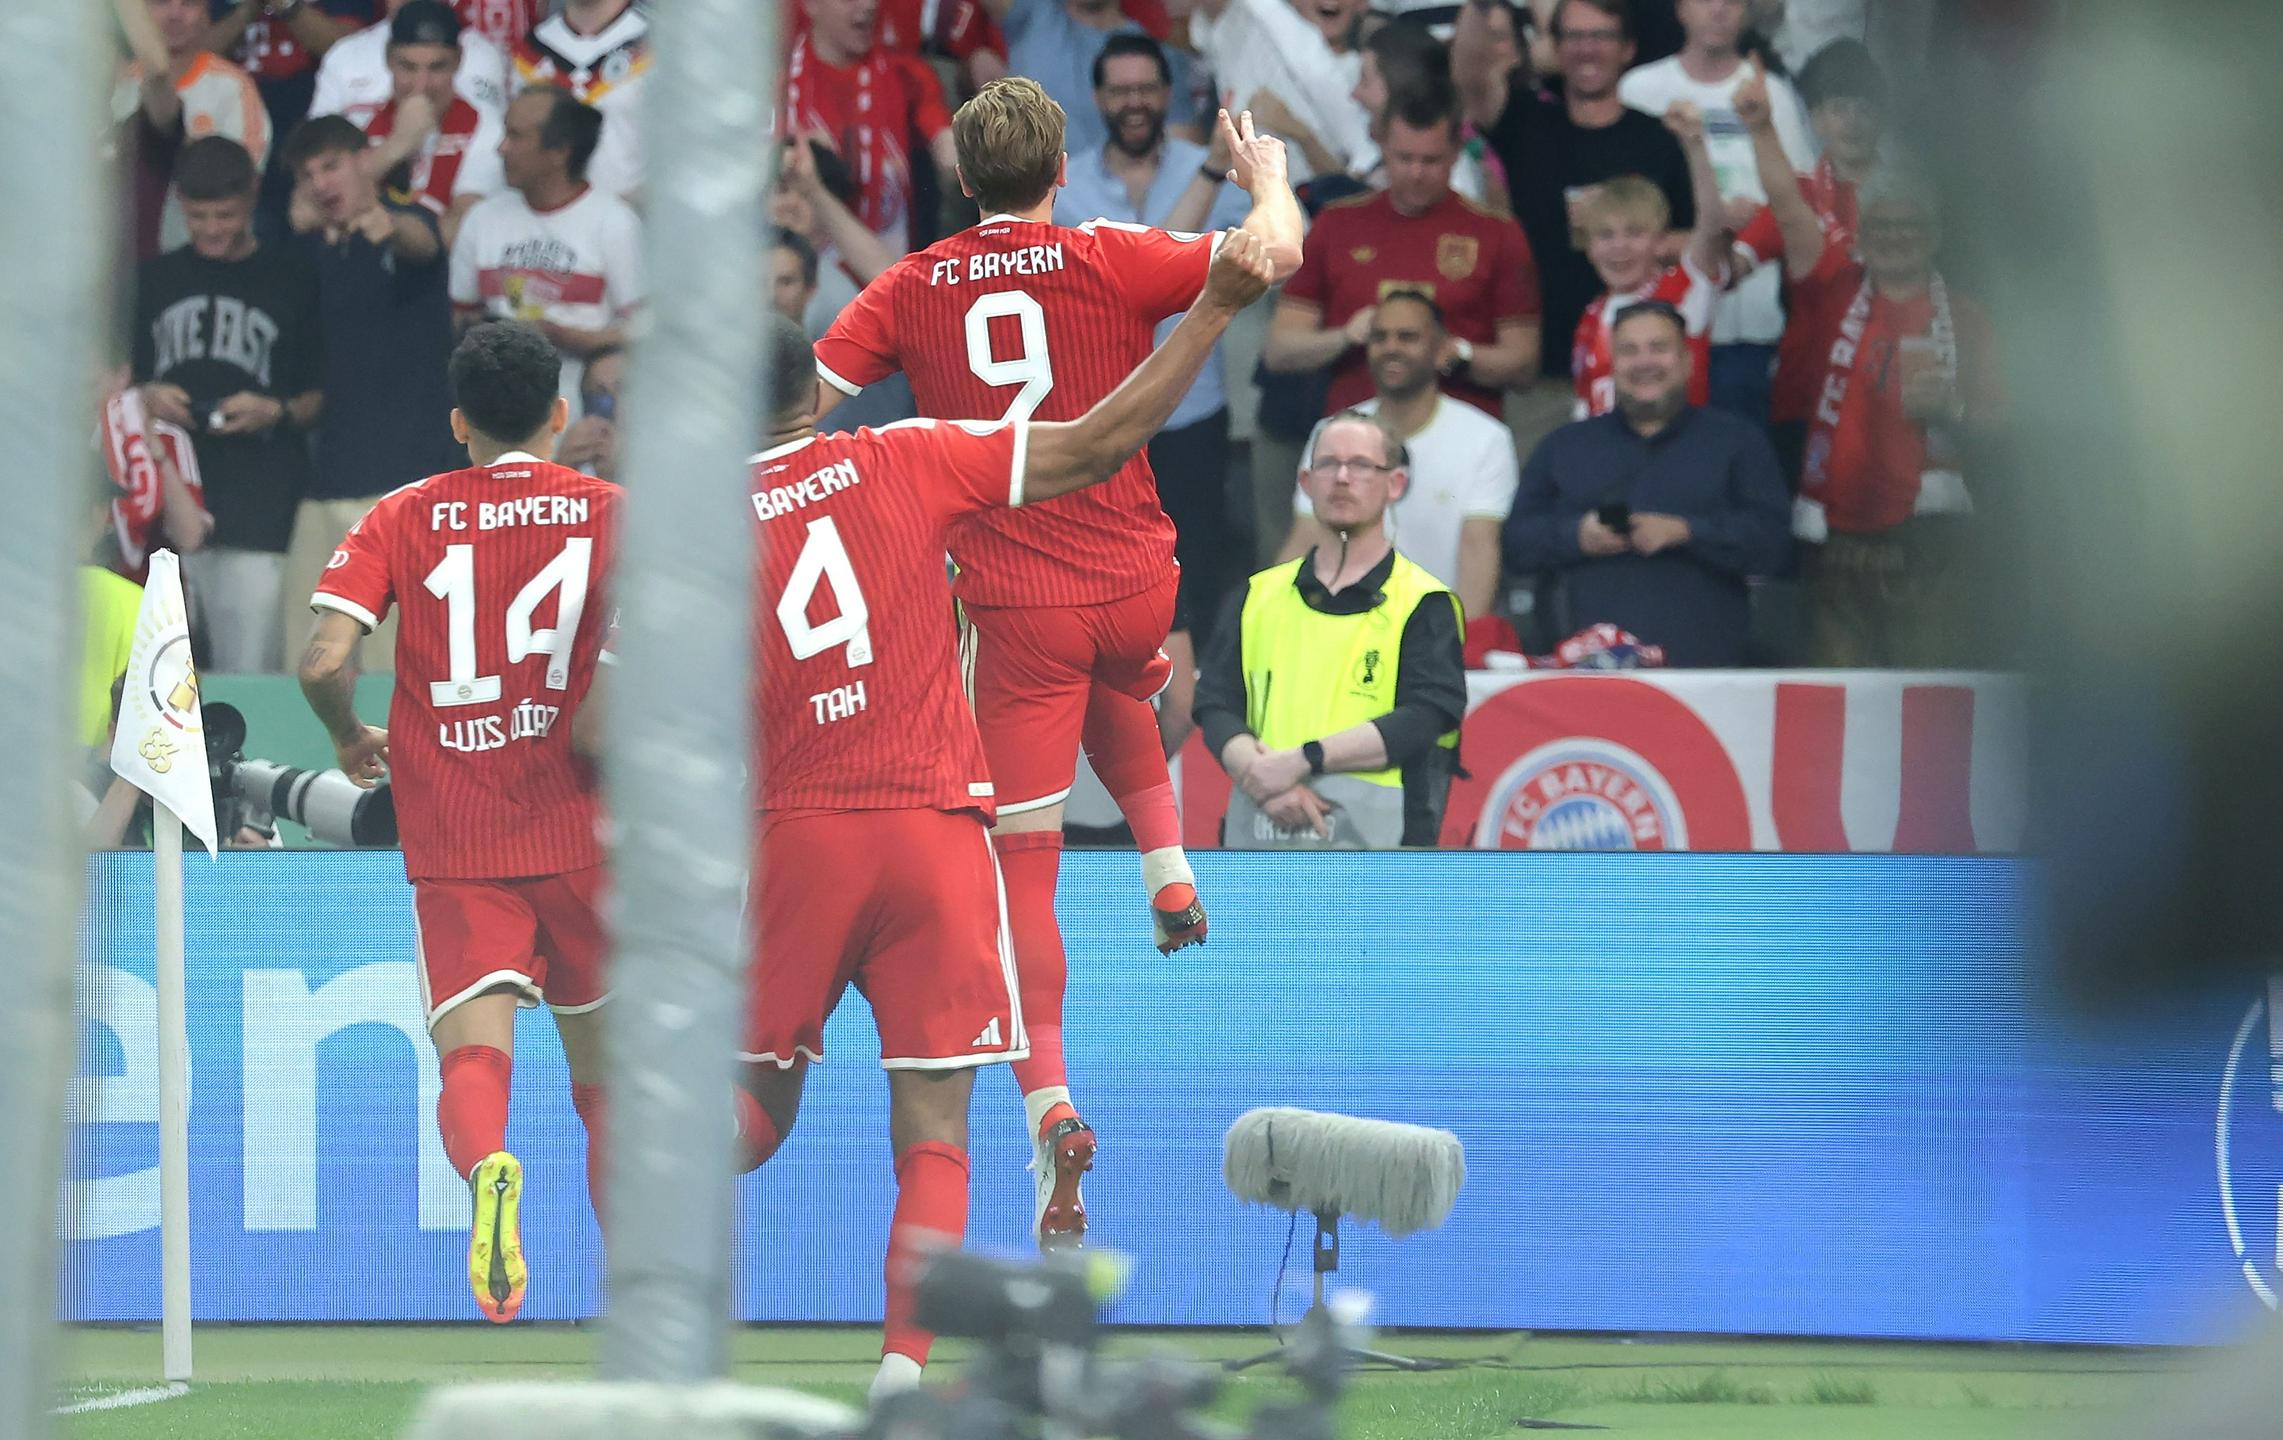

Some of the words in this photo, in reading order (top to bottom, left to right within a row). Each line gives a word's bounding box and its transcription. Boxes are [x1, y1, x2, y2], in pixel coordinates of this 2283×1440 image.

[930, 259, 961, 286] FC
[968, 242, 1064, 281] BAYERN
[964, 289, 1053, 424] 9
[431, 501, 468, 531] FC
[478, 496, 589, 530] BAYERN
[751, 458, 860, 521] BAYERN
[423, 537, 593, 707] 14
[776, 515, 873, 668] 4
[439, 715, 507, 752] LUIS
[510, 697, 560, 741] DÍAZ
[809, 680, 867, 725] TAH
[1503, 794, 1542, 841] FC
[1539, 764, 1658, 842] BAYERN
